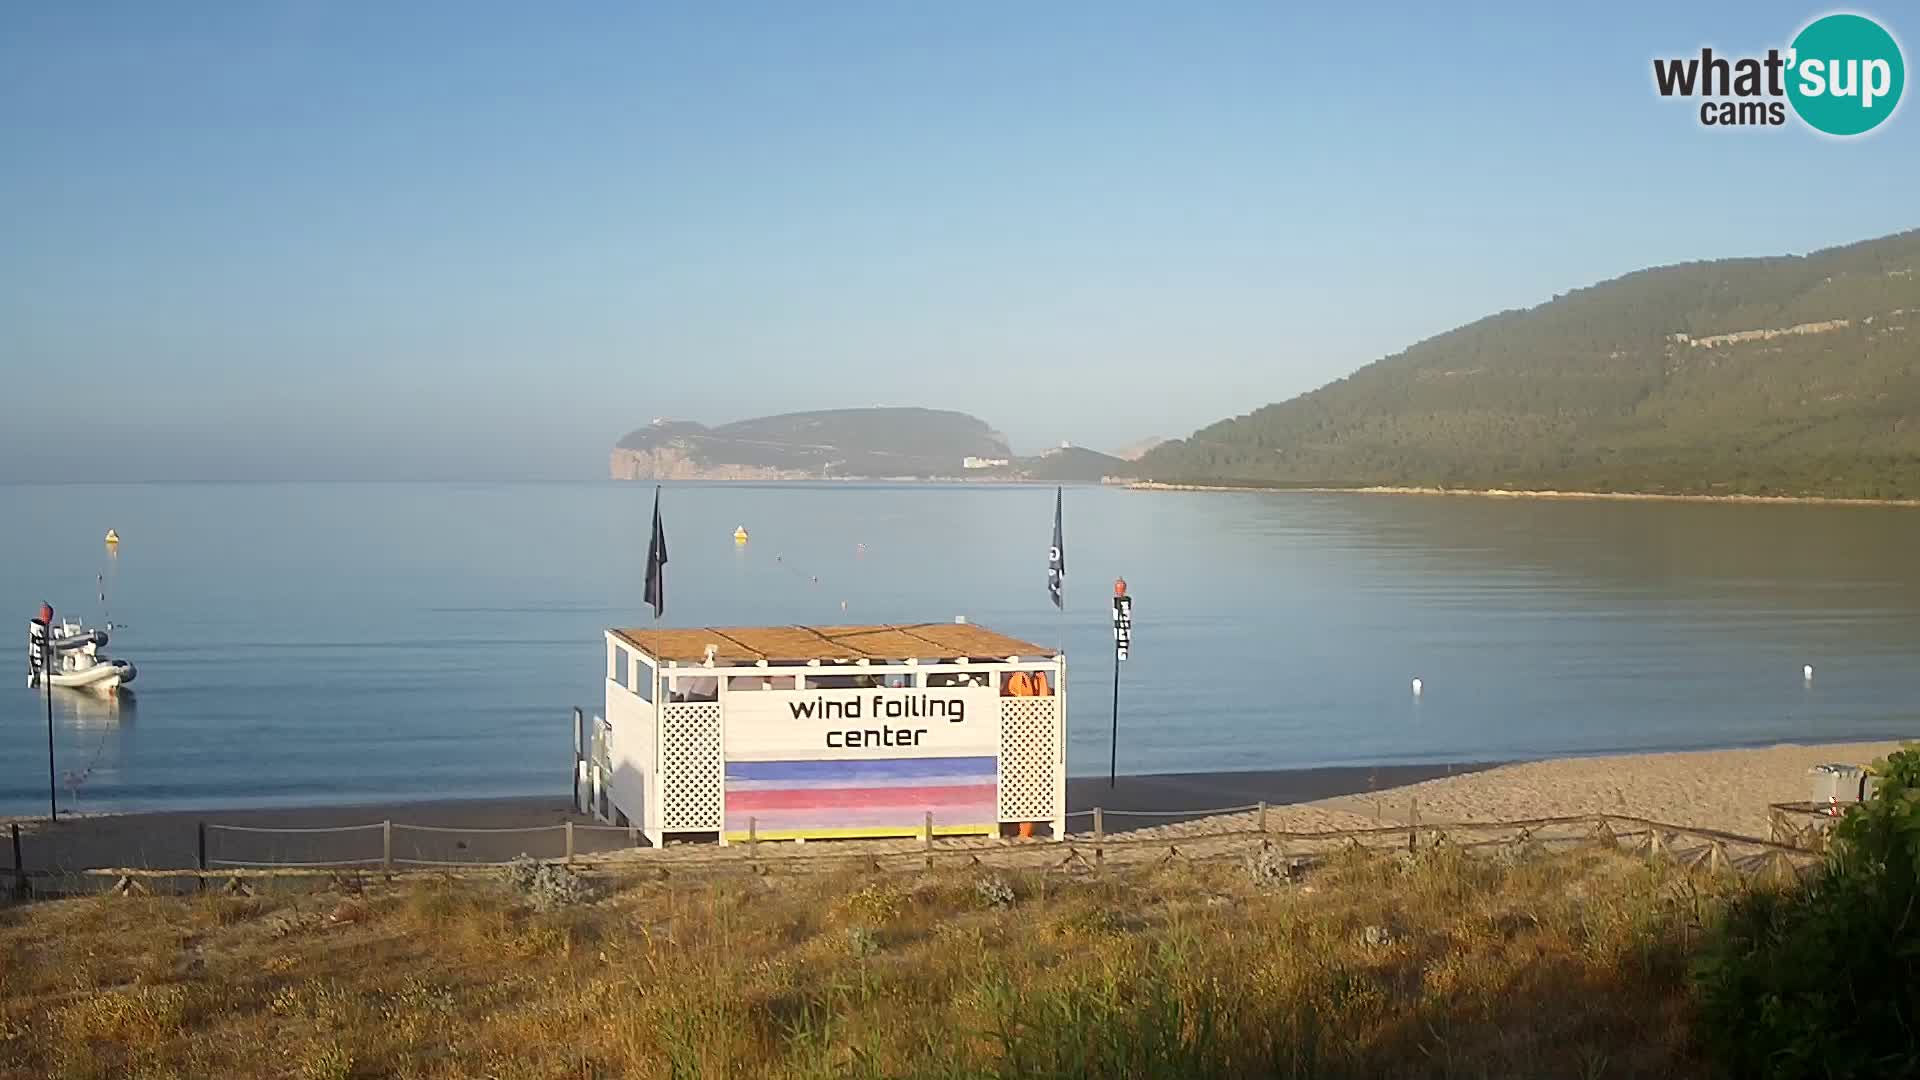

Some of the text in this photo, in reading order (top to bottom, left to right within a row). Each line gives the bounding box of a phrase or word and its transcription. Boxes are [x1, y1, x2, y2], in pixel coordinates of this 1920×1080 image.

[788, 694, 965, 723] wind foiling
[826, 725, 928, 748] center
